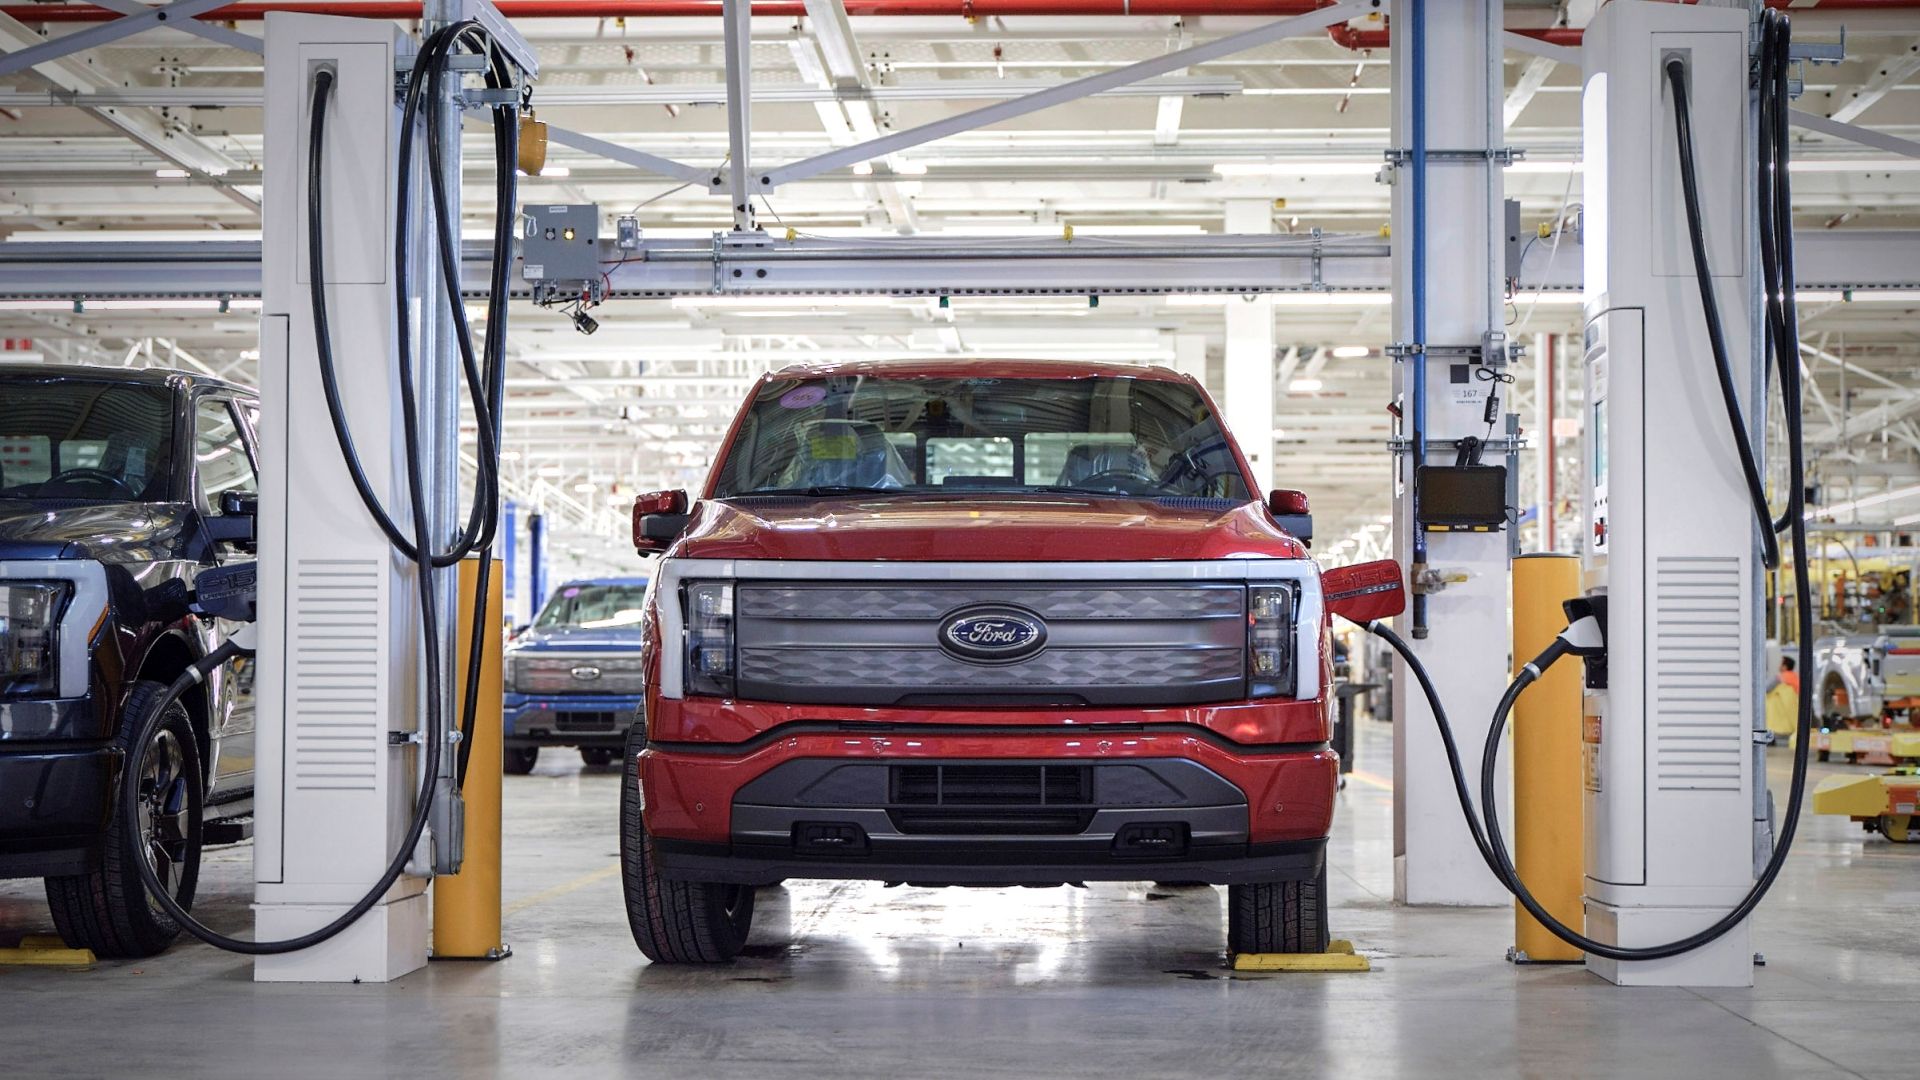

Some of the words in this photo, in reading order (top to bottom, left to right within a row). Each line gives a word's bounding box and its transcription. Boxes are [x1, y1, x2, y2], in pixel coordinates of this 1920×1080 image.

[1463, 390, 1477, 398] 167
[199, 569, 257, 592] F-15
[1326, 566, 1397, 593] F-150
[969, 622, 1017, 642] Ford
